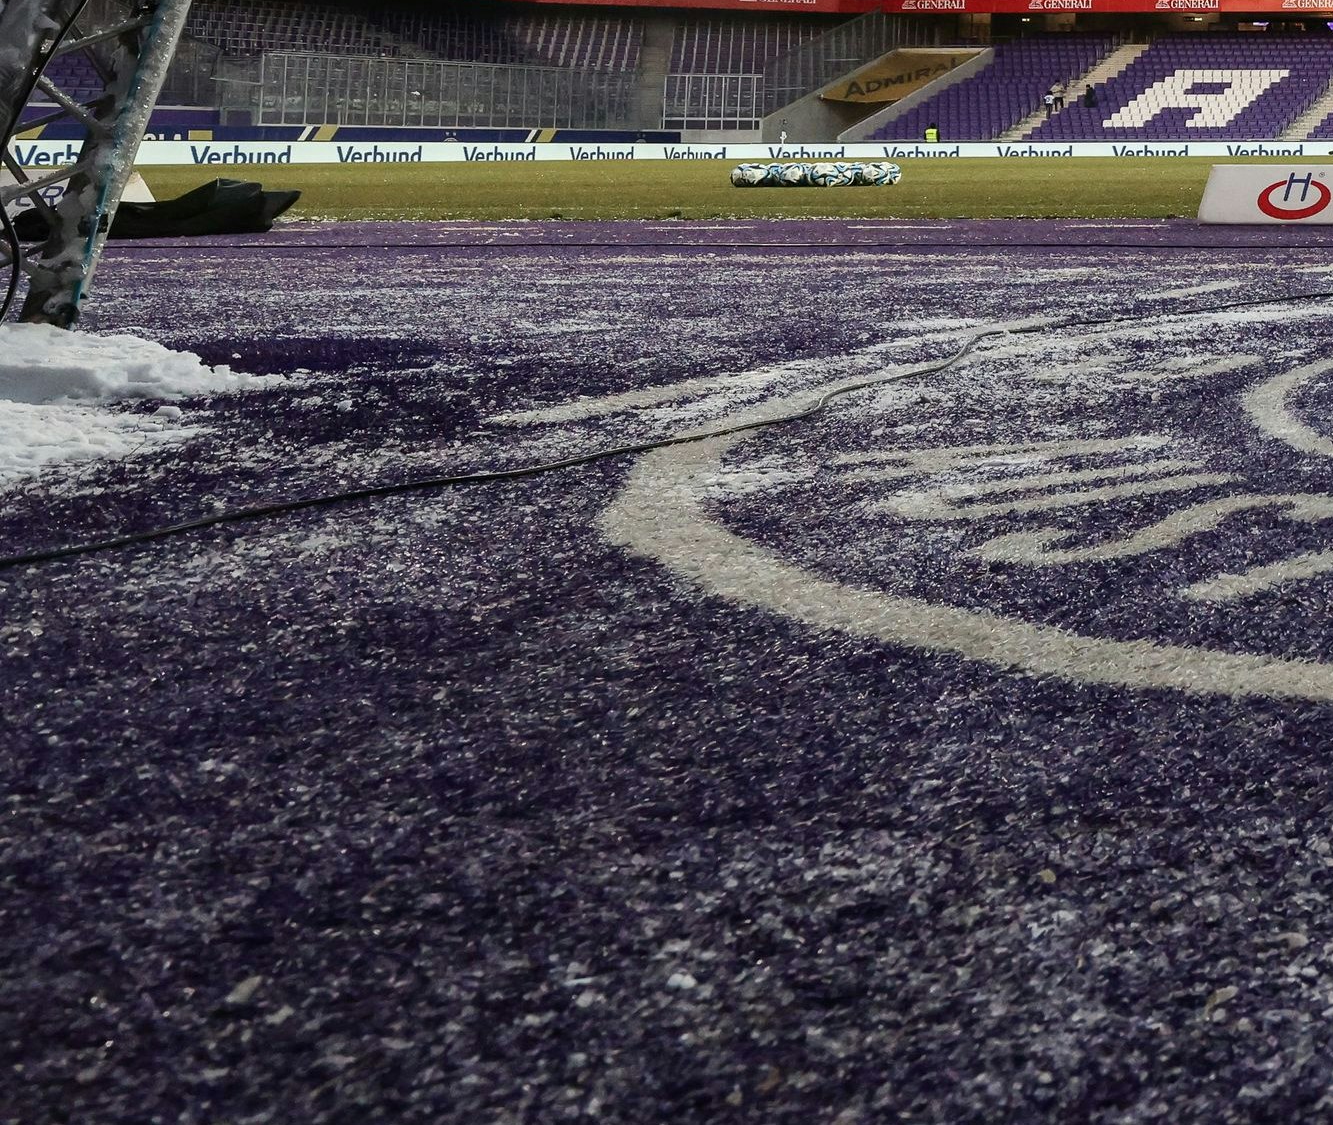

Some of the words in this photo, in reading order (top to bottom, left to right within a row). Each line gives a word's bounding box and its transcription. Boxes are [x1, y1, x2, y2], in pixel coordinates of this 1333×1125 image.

[917, 0, 966, 9] GENERALI
[1044, 0, 1092, 9] GENERALI
[191, 145, 291, 164] Verbund
[337, 145, 422, 163] Verbund
[463, 145, 536, 162] Verbund
[570, 146, 634, 160] Verbund
[664, 146, 727, 160] Verbund
[768, 146, 845, 158] Verbund
[882, 146, 960, 158] Verbund
[996, 146, 1073, 156] Verbund
[1111, 145, 1189, 156] Verbund
[1226, 145, 1304, 156] Verbund
